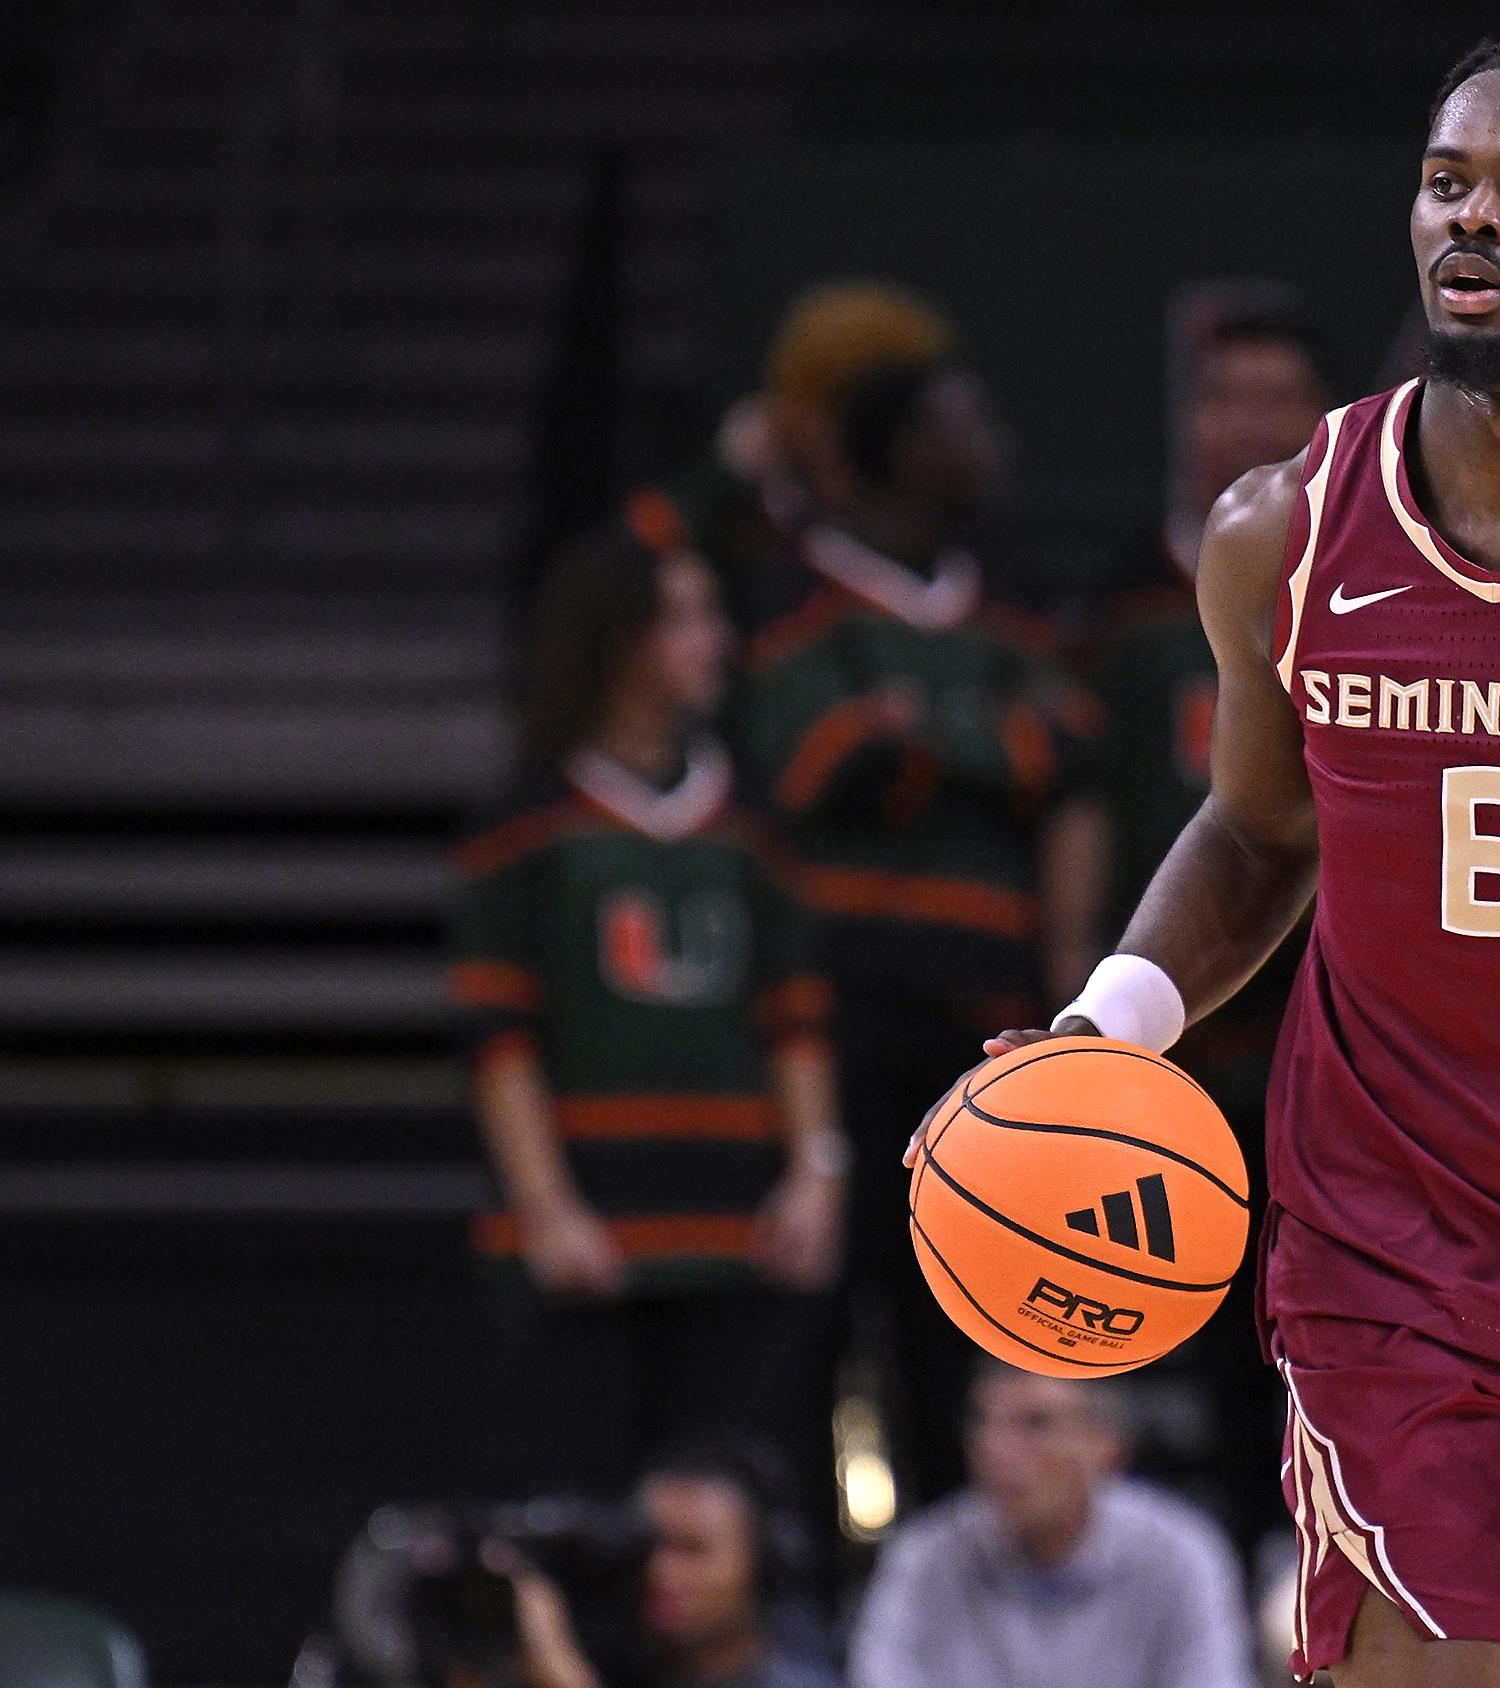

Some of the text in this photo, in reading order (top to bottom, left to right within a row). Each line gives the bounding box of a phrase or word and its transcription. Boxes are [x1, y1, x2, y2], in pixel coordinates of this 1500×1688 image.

[598, 890, 754, 1006] U
[1017, 1307, 1064, 1335] OFFICIAL
[1067, 1330, 1099, 1345] GAME
[1099, 1338, 1126, 1349] BALL
[1026, 1276, 1145, 1336] PRO
